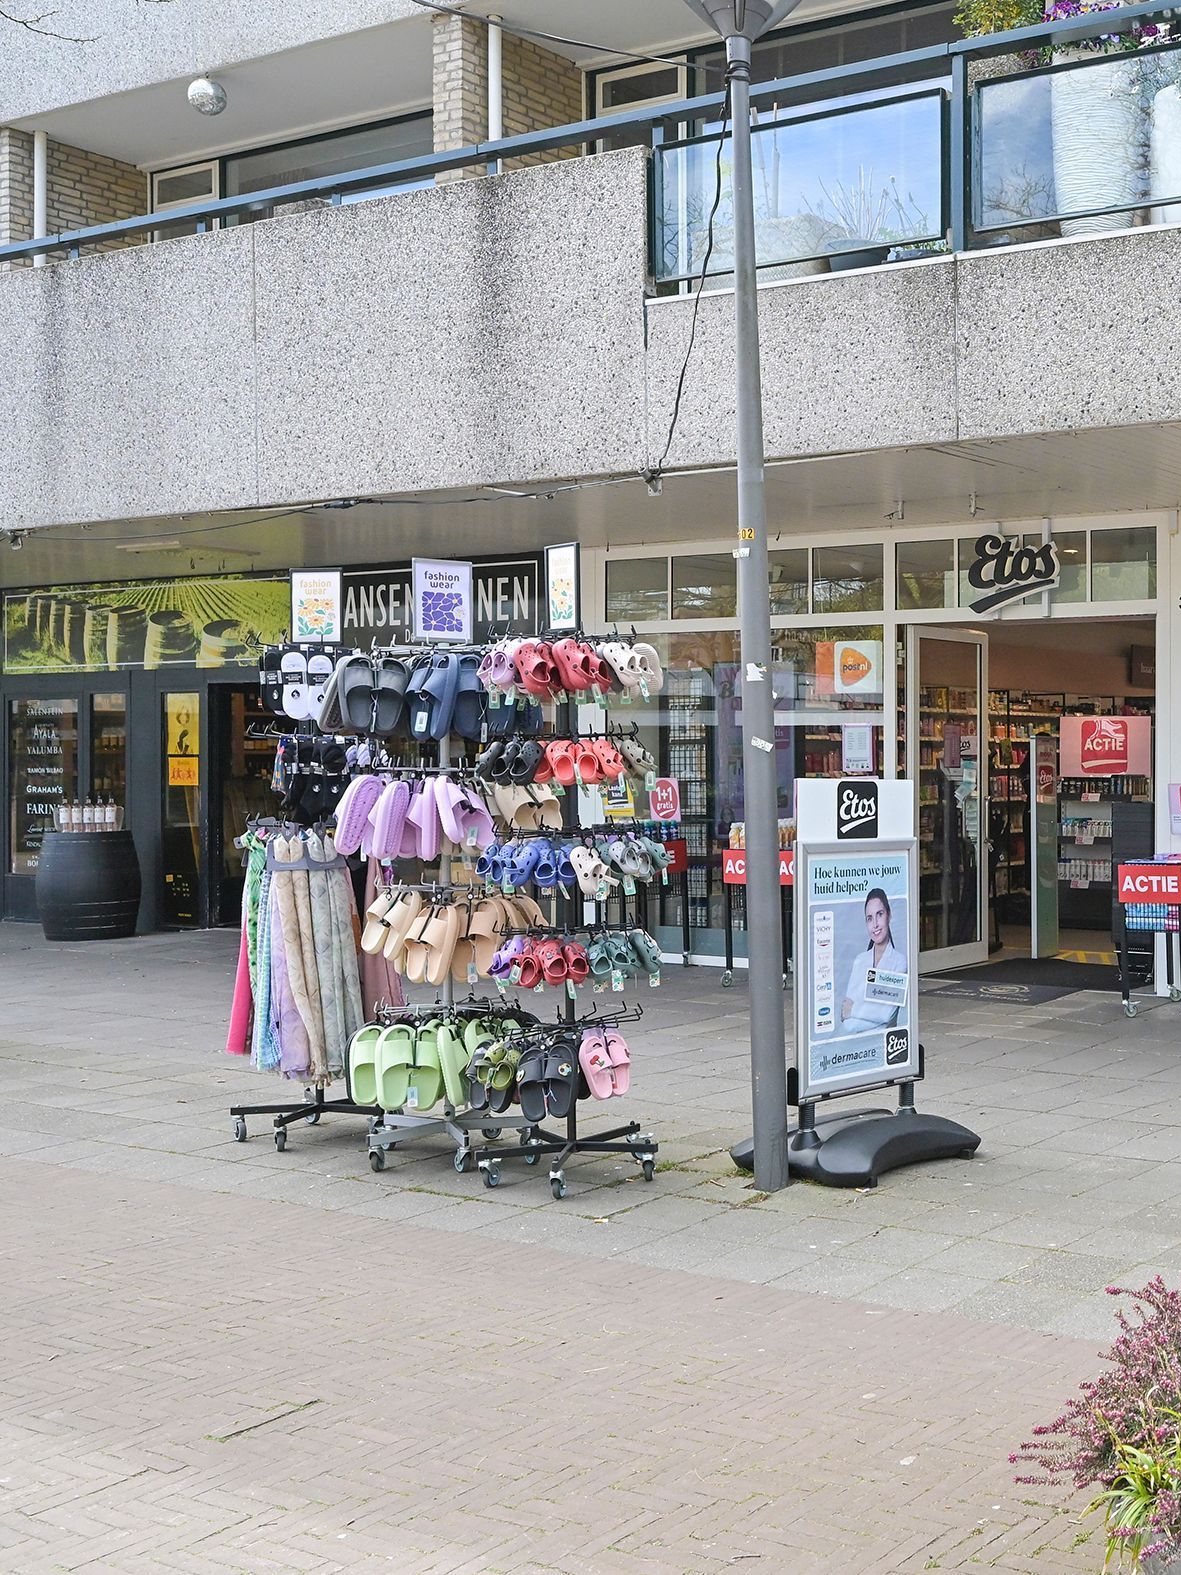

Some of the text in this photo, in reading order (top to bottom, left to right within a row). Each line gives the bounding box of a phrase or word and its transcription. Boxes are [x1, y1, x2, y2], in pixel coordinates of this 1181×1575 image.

[968, 533, 1058, 589] Etos
[424, 570, 460, 582] fashion
[300, 579, 332, 589] fashion
[430, 581, 455, 590] wear
[304, 588, 328, 596] wear
[343, 575, 530, 628] ANSEN NEN
[26, 746, 63, 755] YALUMBA
[1084, 738, 1124, 751] ACTIE
[26, 784, 63, 794] GRAHAM'S
[656, 786, 672, 802] 1+1
[26, 803, 58, 815] FARIN
[656, 802, 674, 810] gratis
[840, 790, 876, 820] Etos
[814, 864, 901, 880] Hoe kunnen we jouw
[814, 880, 868, 895] huid helpen?
[1122, 876, 1178, 892] ACTIE
[888, 1035, 908, 1052] Etos
[832, 1048, 876, 1064] dermacare
